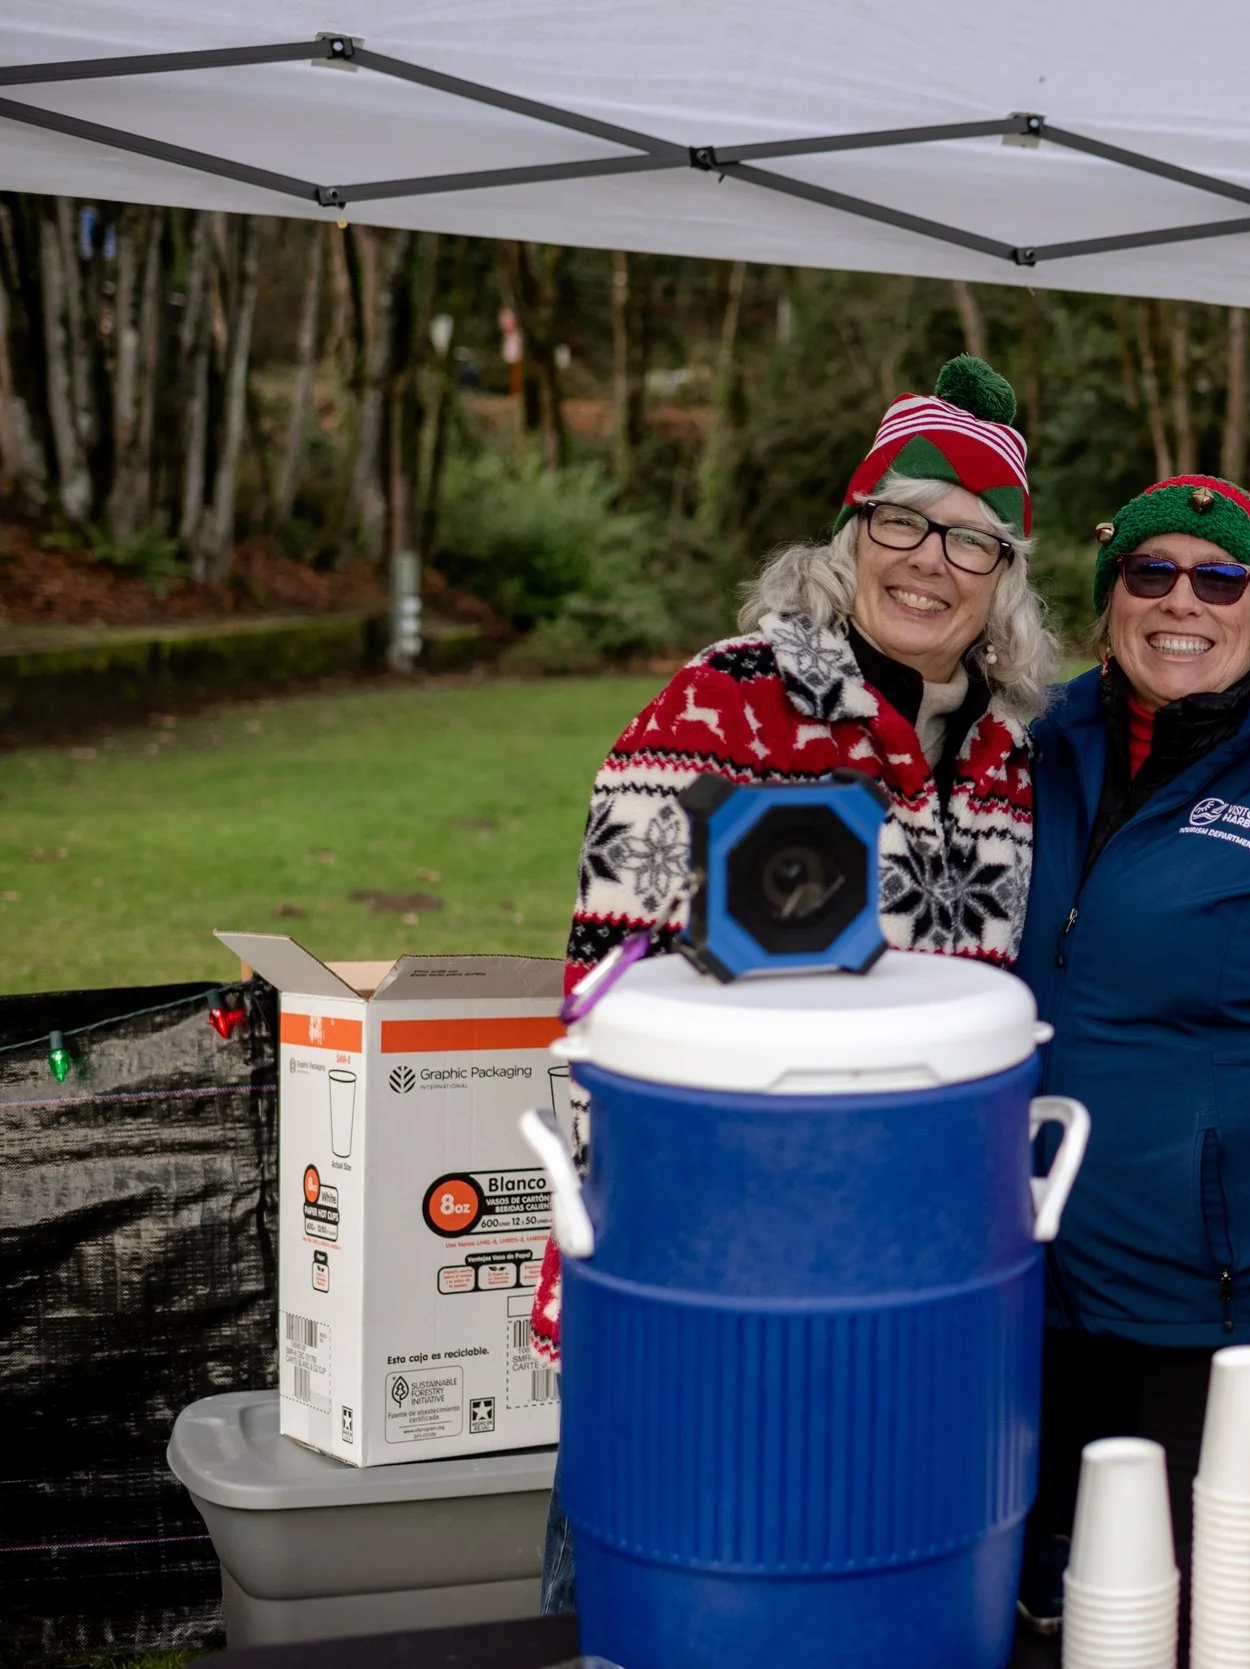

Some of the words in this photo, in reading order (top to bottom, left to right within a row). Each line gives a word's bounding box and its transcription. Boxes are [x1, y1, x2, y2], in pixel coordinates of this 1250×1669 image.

[1179, 826, 1209, 836] TOURISM
[420, 1066, 468, 1081] Graphic
[471, 1065, 532, 1080] Packaging
[488, 1176, 547, 1193] Blanco
[321, 1191, 337, 1205] White
[440, 1193, 471, 1216] 8oz
[485, 1198, 510, 1206] VASOS
[510, 1197, 520, 1205] DE
[521, 1193, 550, 1204] CARTÓN
[304, 1205, 318, 1217] PAPER
[317, 1207, 327, 1219] HOT
[327, 1210, 339, 1222] CUPS
[495, 1204, 524, 1213] BEBIDAS
[525, 1203, 549, 1211] CALIEN
[481, 1218, 499, 1228] 600
[511, 1217, 521, 1226] 12
[525, 1215, 537, 1225] 50
[387, 1354, 406, 1365] Esta
[409, 1352, 429, 1364] caja
[444, 1347, 490, 1359] reciclable.
[512, 1362, 537, 1371] CARTE
[411, 1377, 458, 1390] SUSTAINABLE
[411, 1387, 444, 1397] FORESTRY
[411, 1395, 445, 1405] INITIATIVE
[388, 1411, 407, 1419] Fuente
[417, 1406, 460, 1416] abastecimiento
[409, 1414, 439, 1423] certificada
